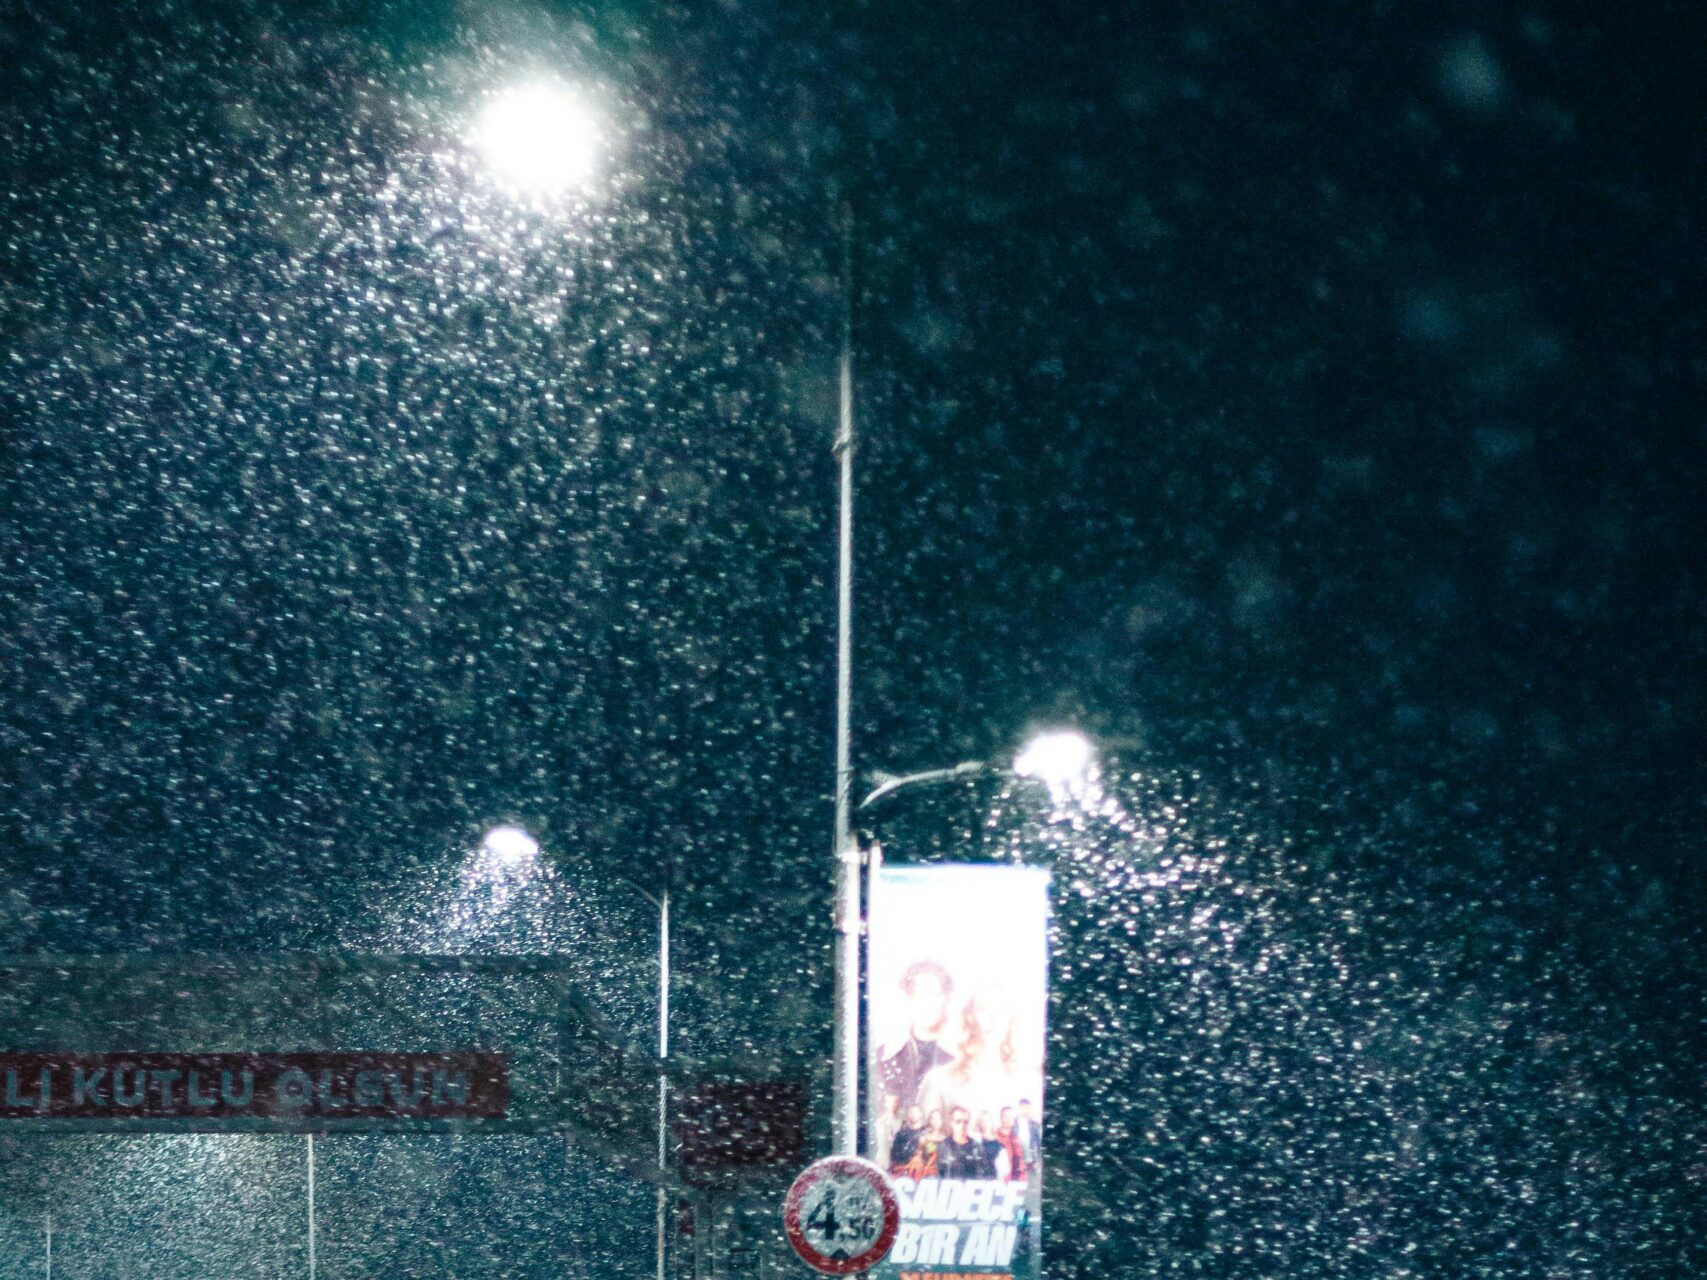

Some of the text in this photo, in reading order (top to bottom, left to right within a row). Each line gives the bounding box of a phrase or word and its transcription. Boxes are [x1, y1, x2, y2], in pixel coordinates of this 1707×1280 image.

[74, 1067, 255, 1107] KUTLU
[275, 1067, 468, 1107] OLSUN
[959, 1224, 1018, 1266] AN
